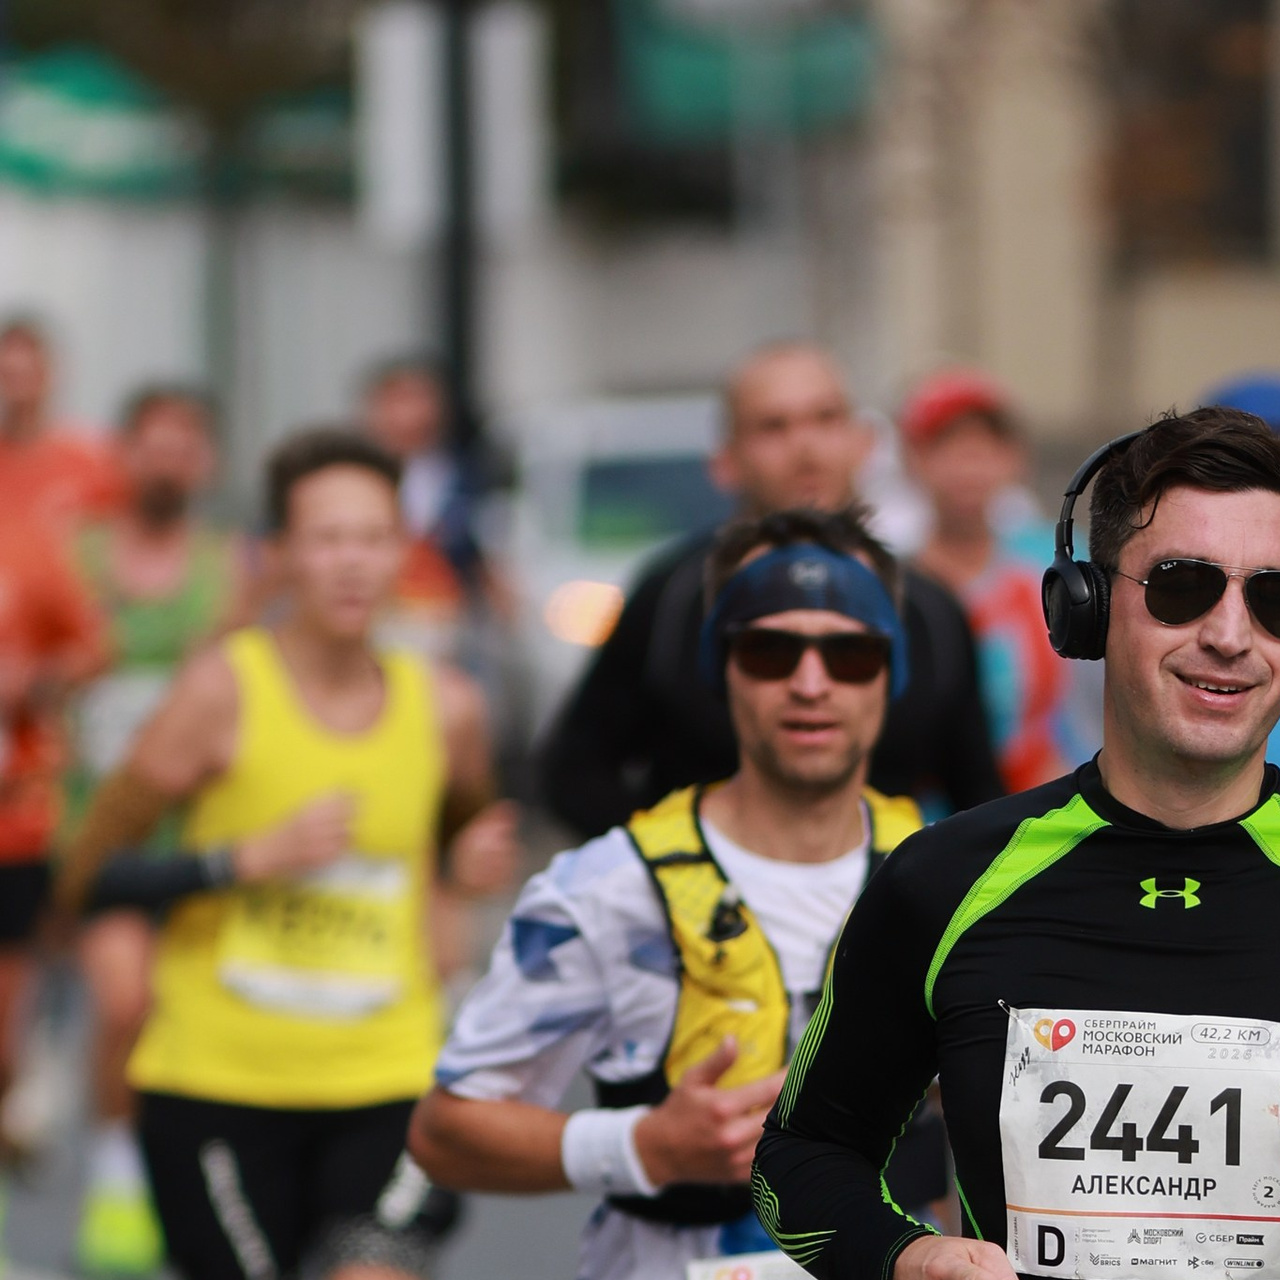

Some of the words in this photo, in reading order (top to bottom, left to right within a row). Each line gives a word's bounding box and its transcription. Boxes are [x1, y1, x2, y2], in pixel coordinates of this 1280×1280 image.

[1084, 1018, 1157, 1031] СБЕРПРАЙМ
[1083, 1030, 1183, 1045] МОСКОВСКИЙ
[1199, 1027, 1232, 1041] 42,2
[1082, 1043, 1156, 1057] МАРАФОН
[1038, 1080, 1242, 1167] 2441
[1071, 1174, 1217, 1201] АЛЕКСАНДР
[1263, 1185, 1274, 1198] 2
[1209, 1234, 1234, 1242] СБЕР
[1037, 1224, 1066, 1267] D
